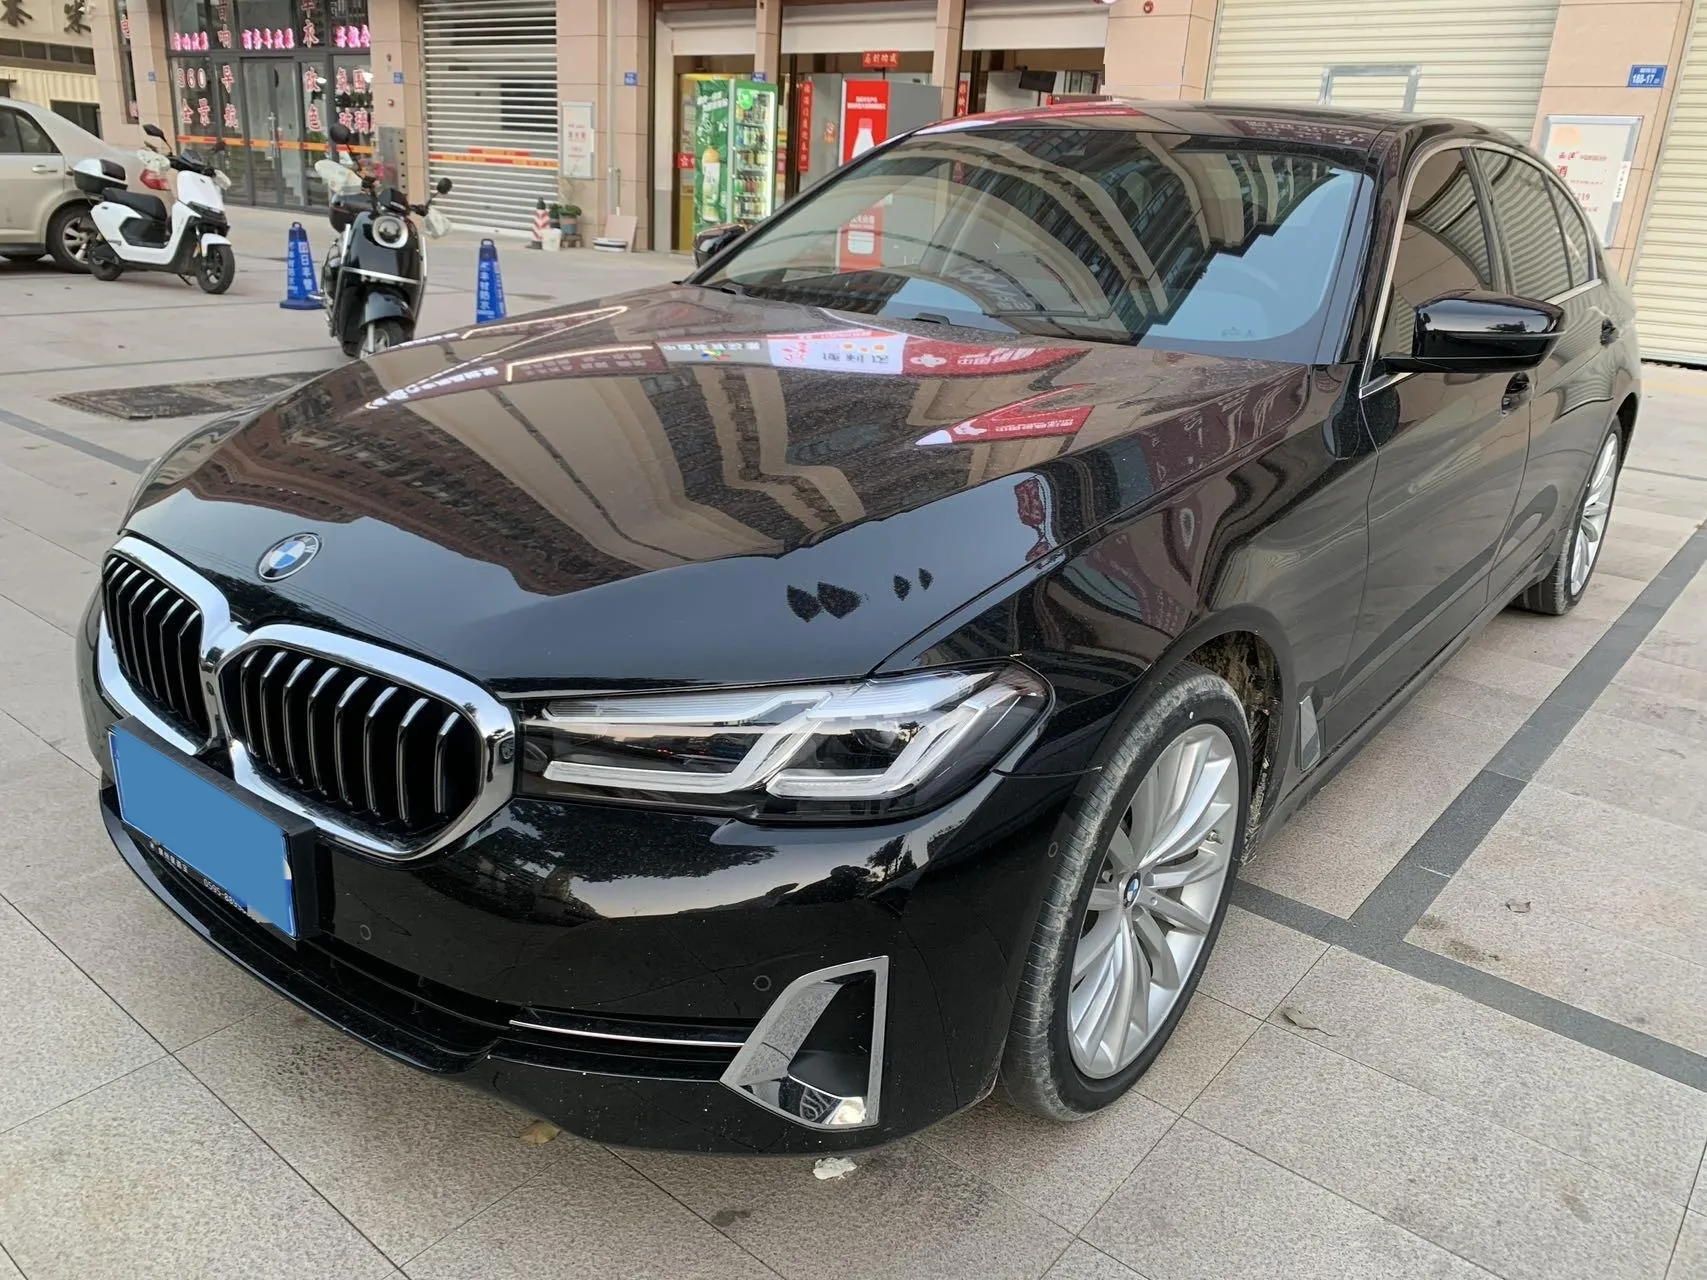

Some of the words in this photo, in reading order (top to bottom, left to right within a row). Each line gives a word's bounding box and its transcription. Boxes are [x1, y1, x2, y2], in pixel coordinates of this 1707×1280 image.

[177, 68, 207, 88] 360
[221, 64, 239, 128] 导航
[183, 98, 210, 126] 全景
